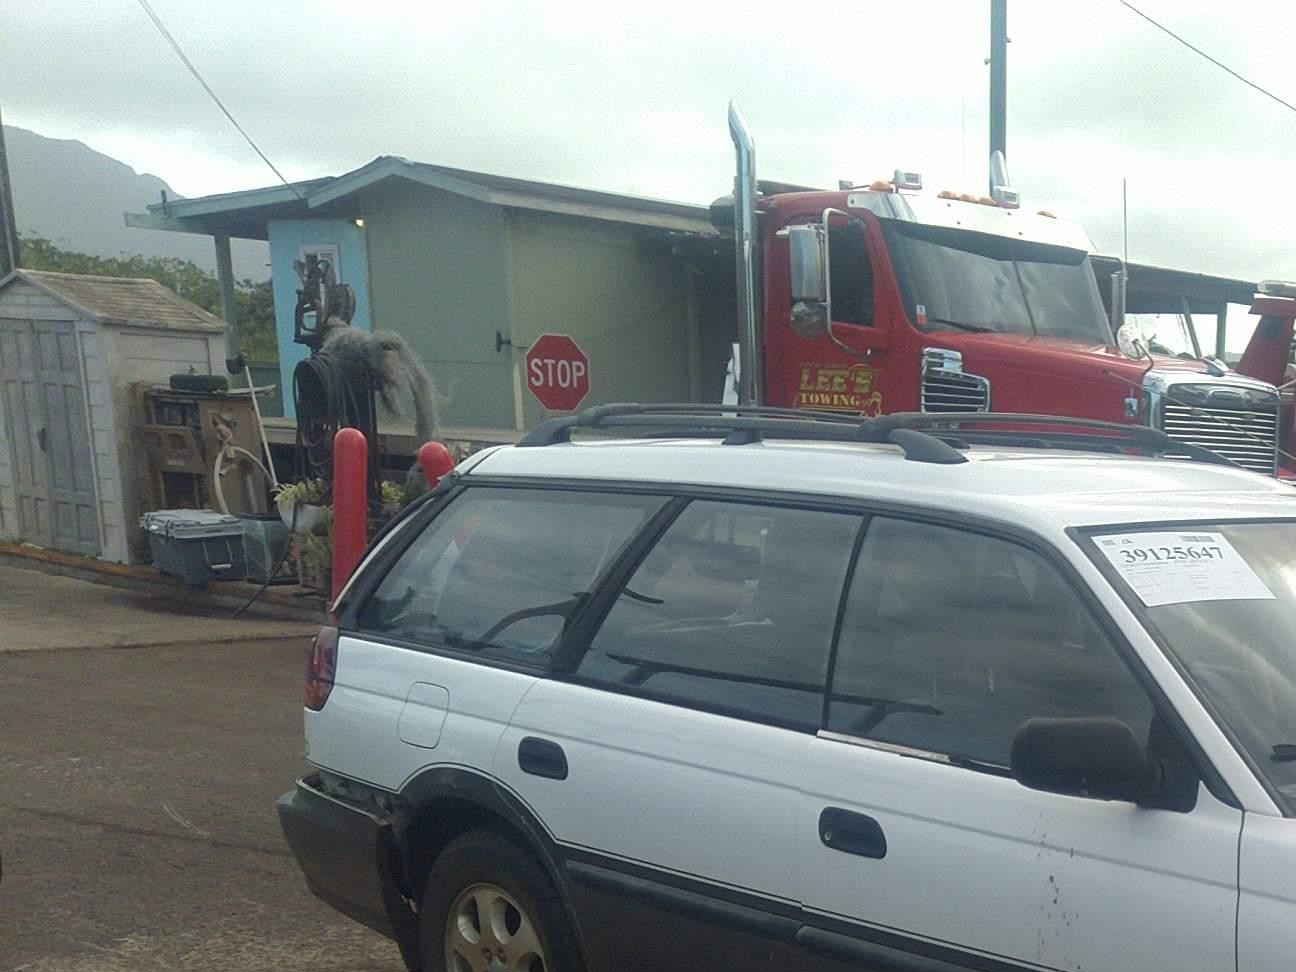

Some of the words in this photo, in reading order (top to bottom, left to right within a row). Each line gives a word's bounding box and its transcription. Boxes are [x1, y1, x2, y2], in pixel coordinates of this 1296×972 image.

[530, 358, 585, 388] STOP
[800, 367, 873, 393] LEE'S
[800, 392, 860, 406] TOWING
[1119, 546, 1223, 563] 39125647
